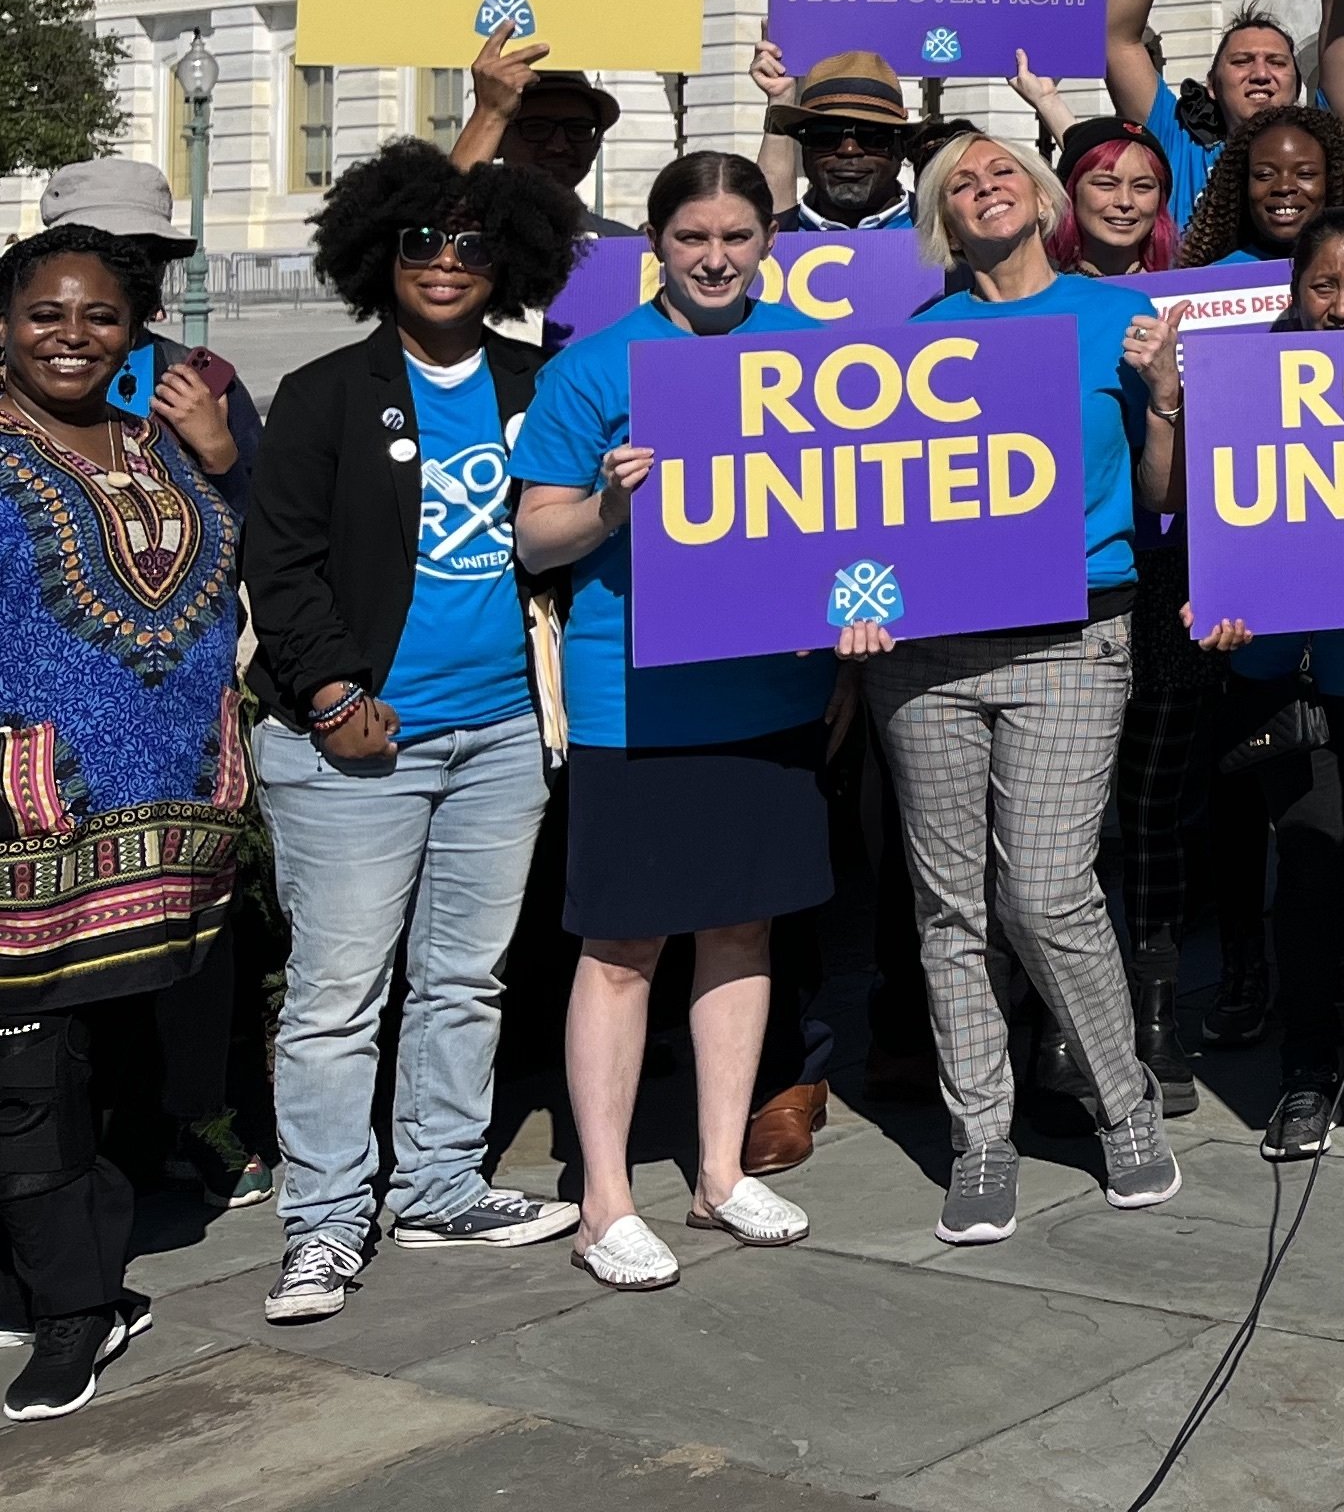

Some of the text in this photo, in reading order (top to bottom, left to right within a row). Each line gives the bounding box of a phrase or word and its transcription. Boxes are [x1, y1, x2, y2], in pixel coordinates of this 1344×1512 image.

[739, 336, 983, 438] ROC
[661, 431, 1057, 546] UNITED
[450, 549, 510, 570] UNITED
